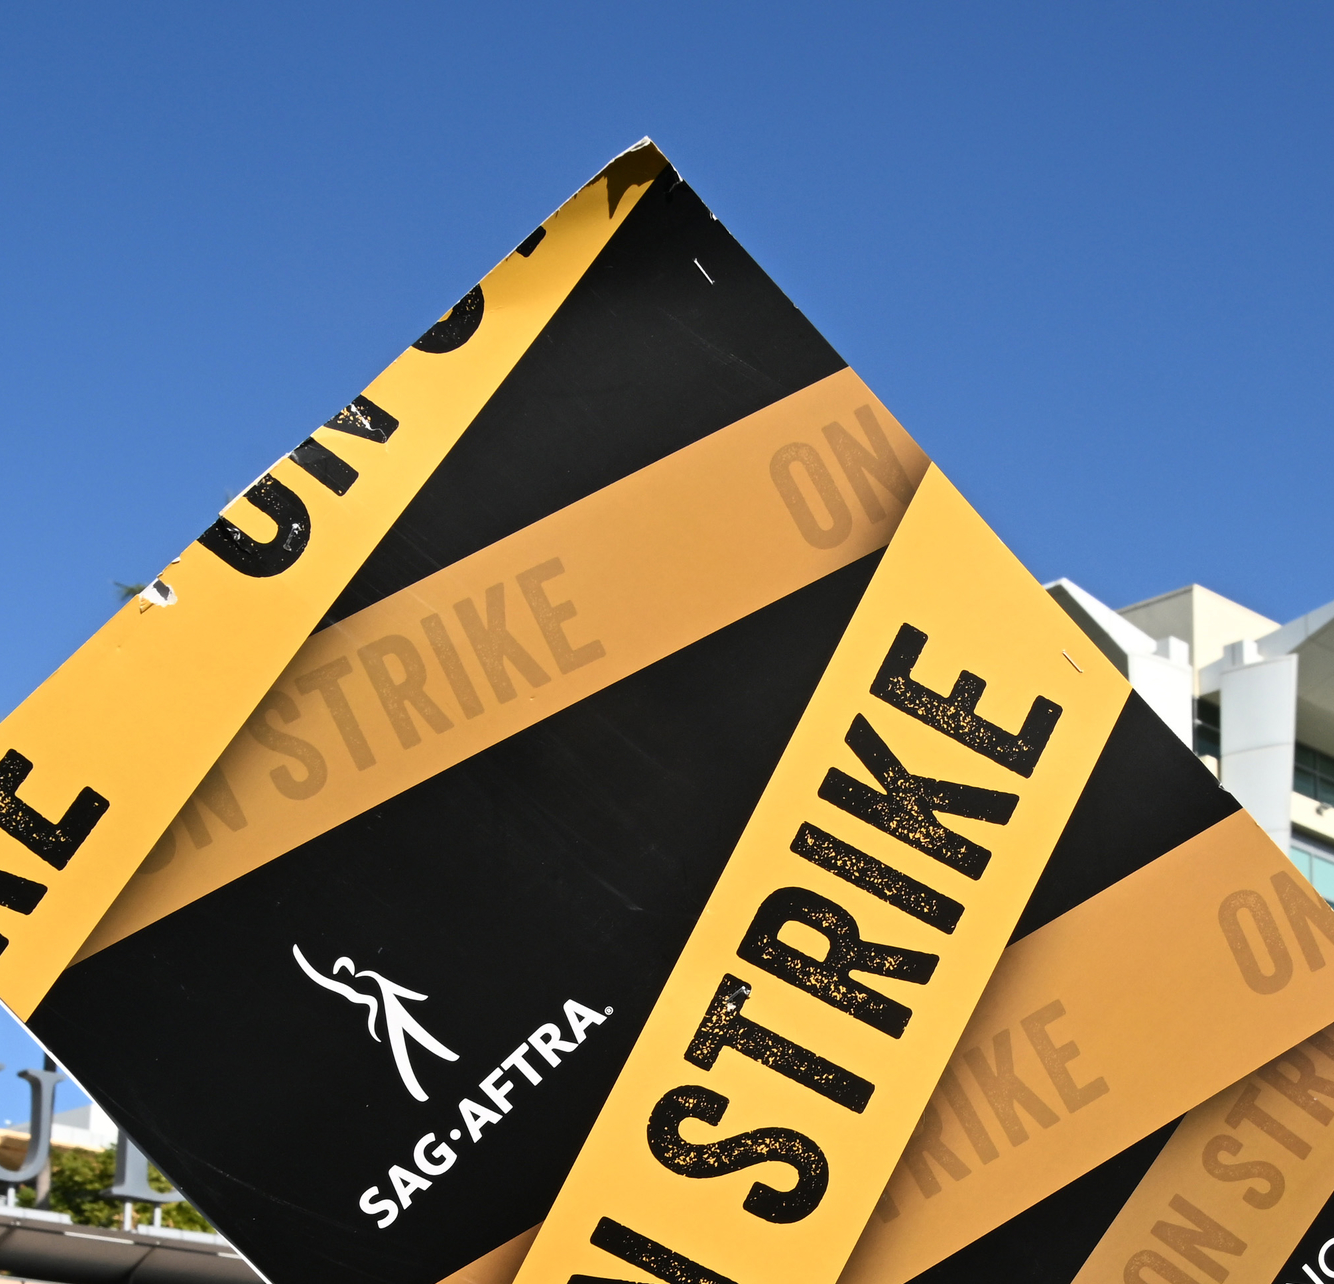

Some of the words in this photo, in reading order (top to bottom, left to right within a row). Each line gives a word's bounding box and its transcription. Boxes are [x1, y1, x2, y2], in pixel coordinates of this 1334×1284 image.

[768, 403, 918, 550] ON
[249, 557, 607, 802] STRIKE
[646, 622, 1065, 1226] STRIKE
[875, 998, 1111, 1224] RIKE
